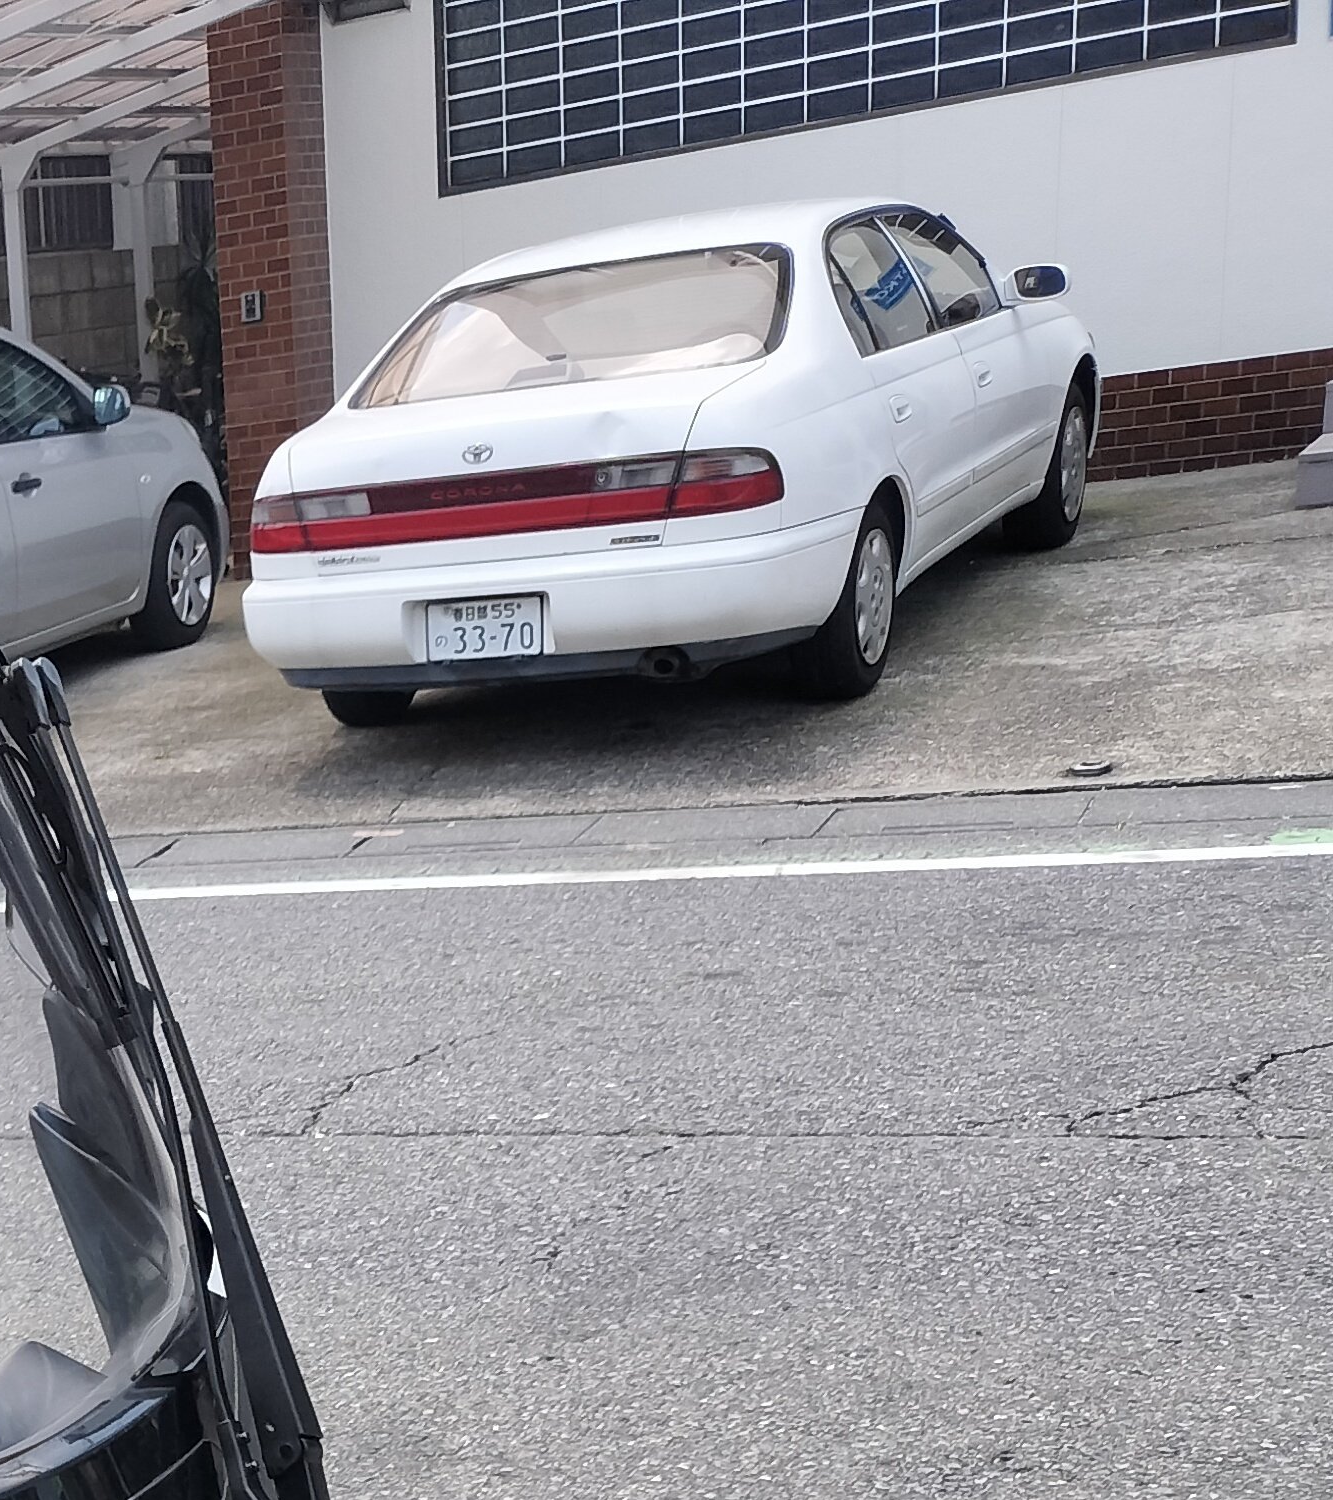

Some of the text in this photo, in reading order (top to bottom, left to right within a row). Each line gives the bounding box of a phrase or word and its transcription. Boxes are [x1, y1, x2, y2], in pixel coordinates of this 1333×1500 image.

[430, 482, 527, 500] CORONA
[435, 621, 535, 655] の 33-70
